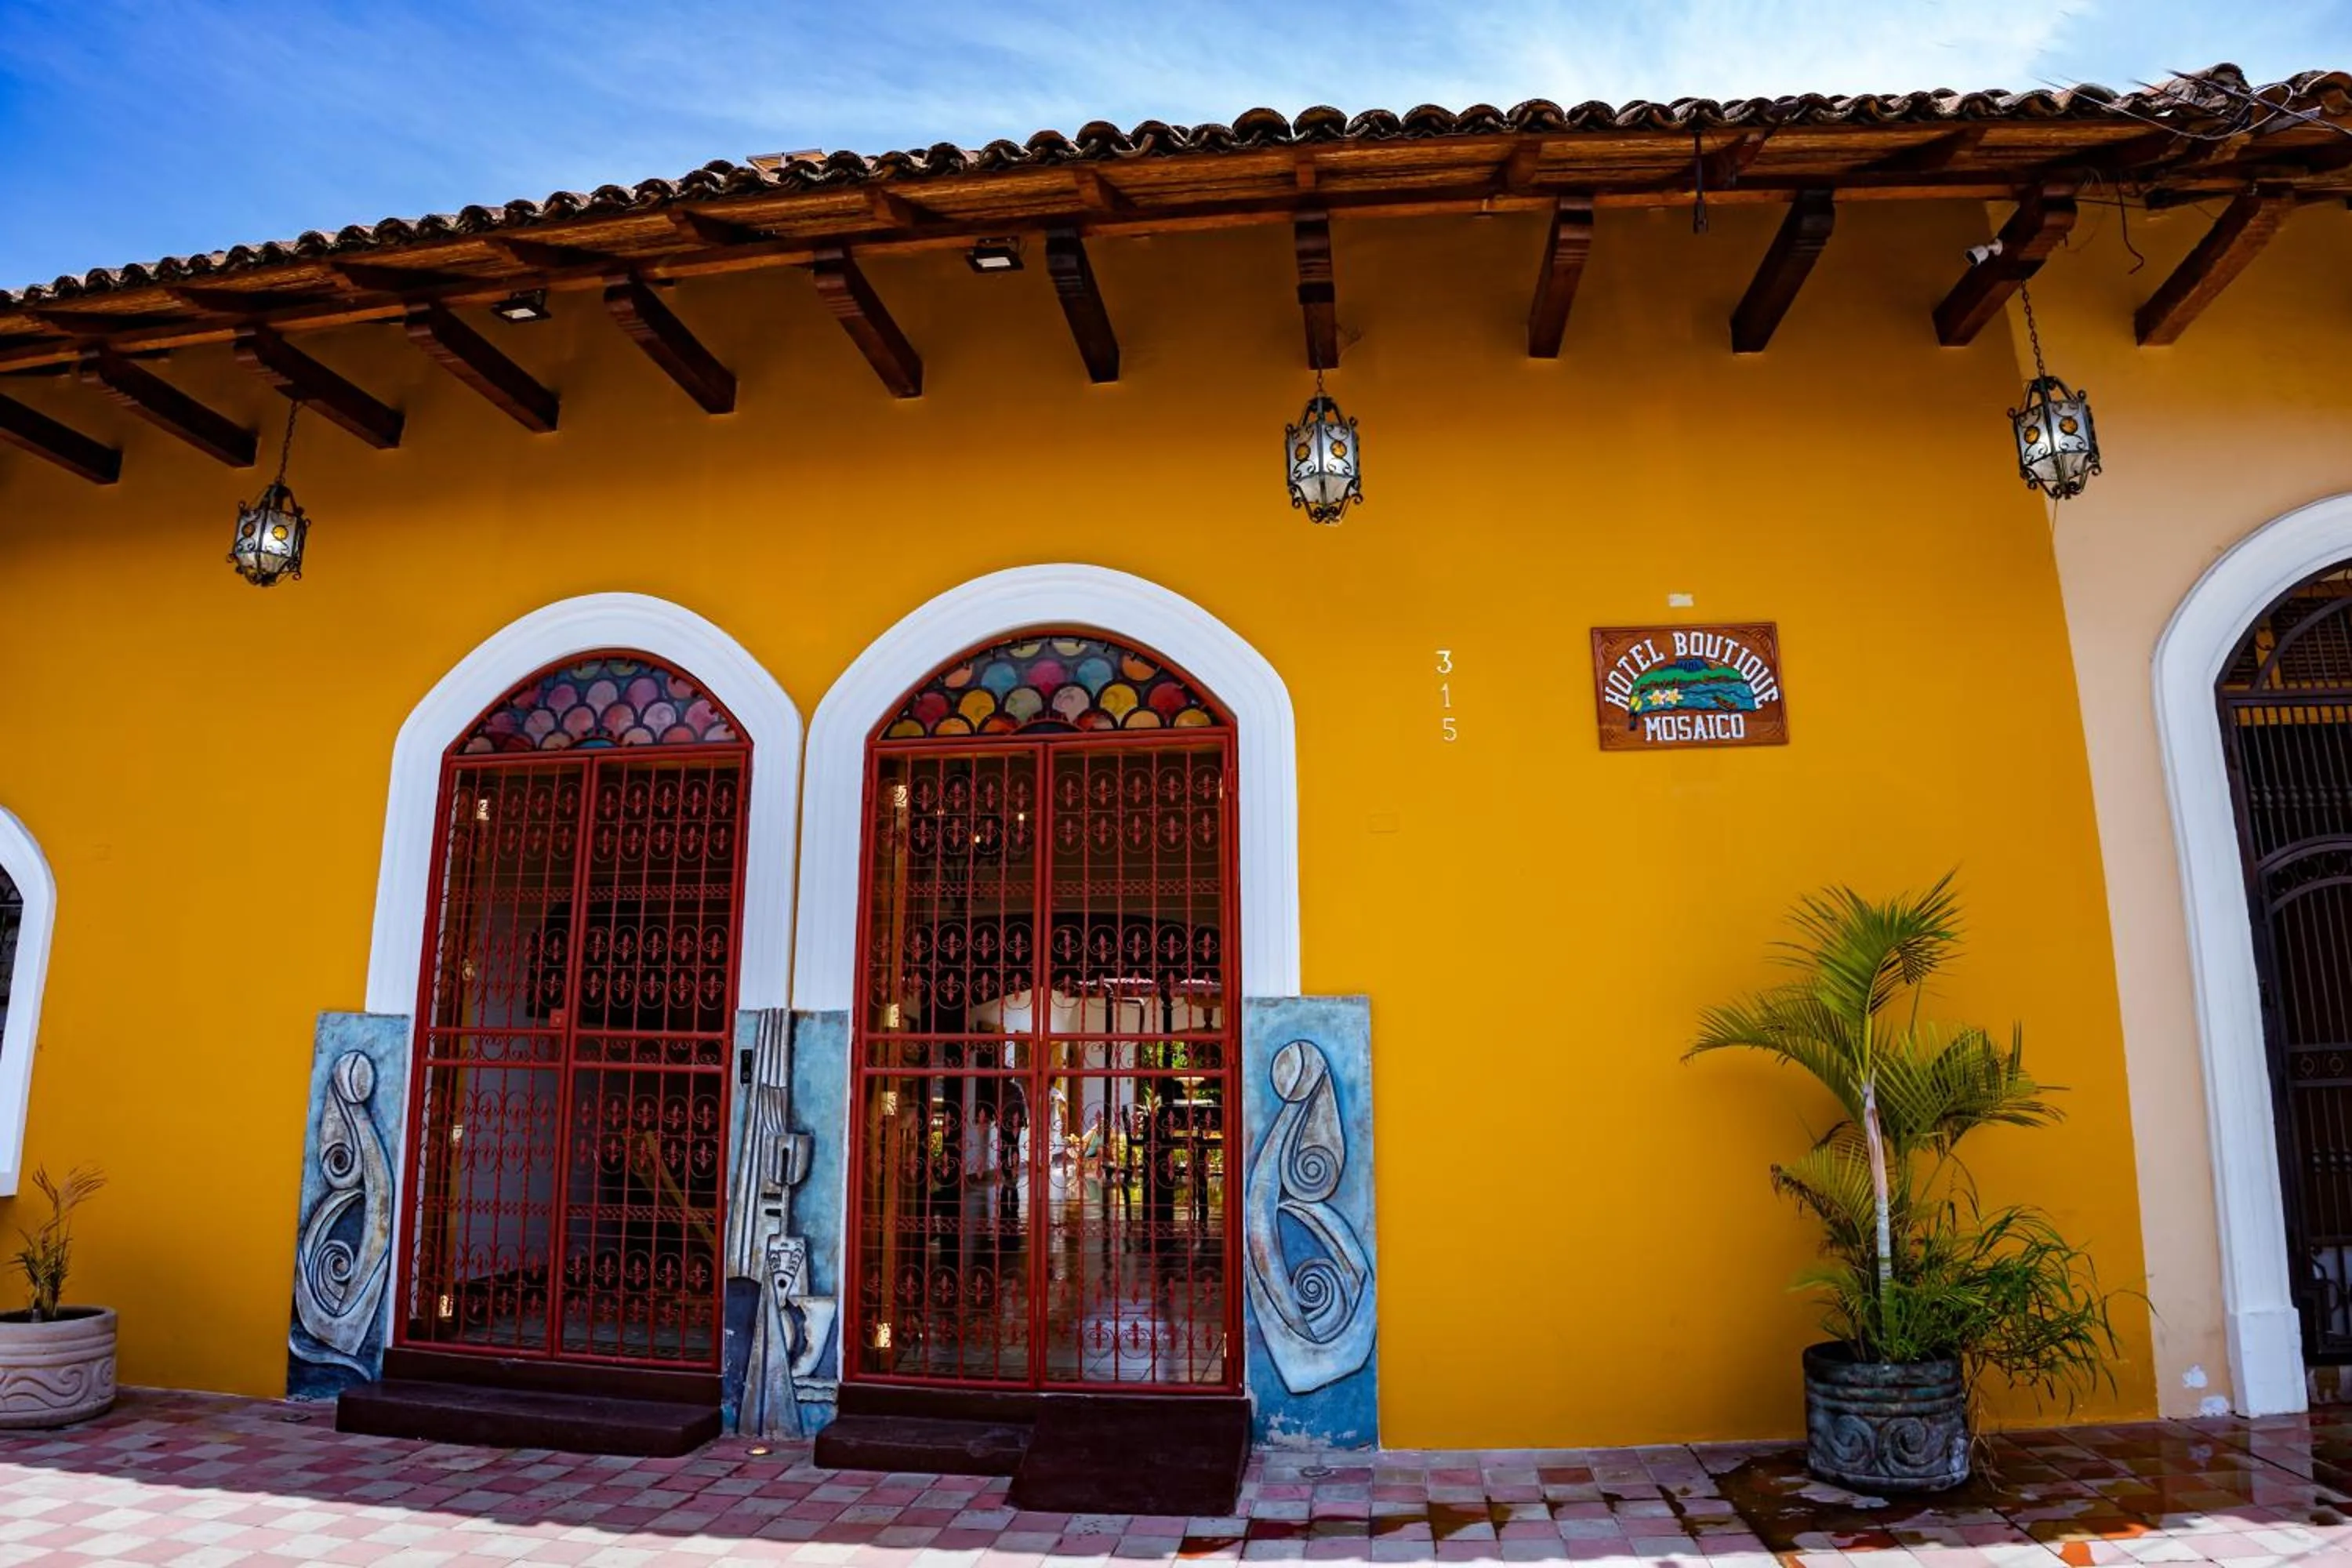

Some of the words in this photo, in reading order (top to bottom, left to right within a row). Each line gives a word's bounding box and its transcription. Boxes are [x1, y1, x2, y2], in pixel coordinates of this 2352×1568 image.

[1605, 639, 1665, 710] HOTEL
[1672, 631, 1780, 710] BOUTIQUE
[1644, 713, 1745, 741] MOSAICO
